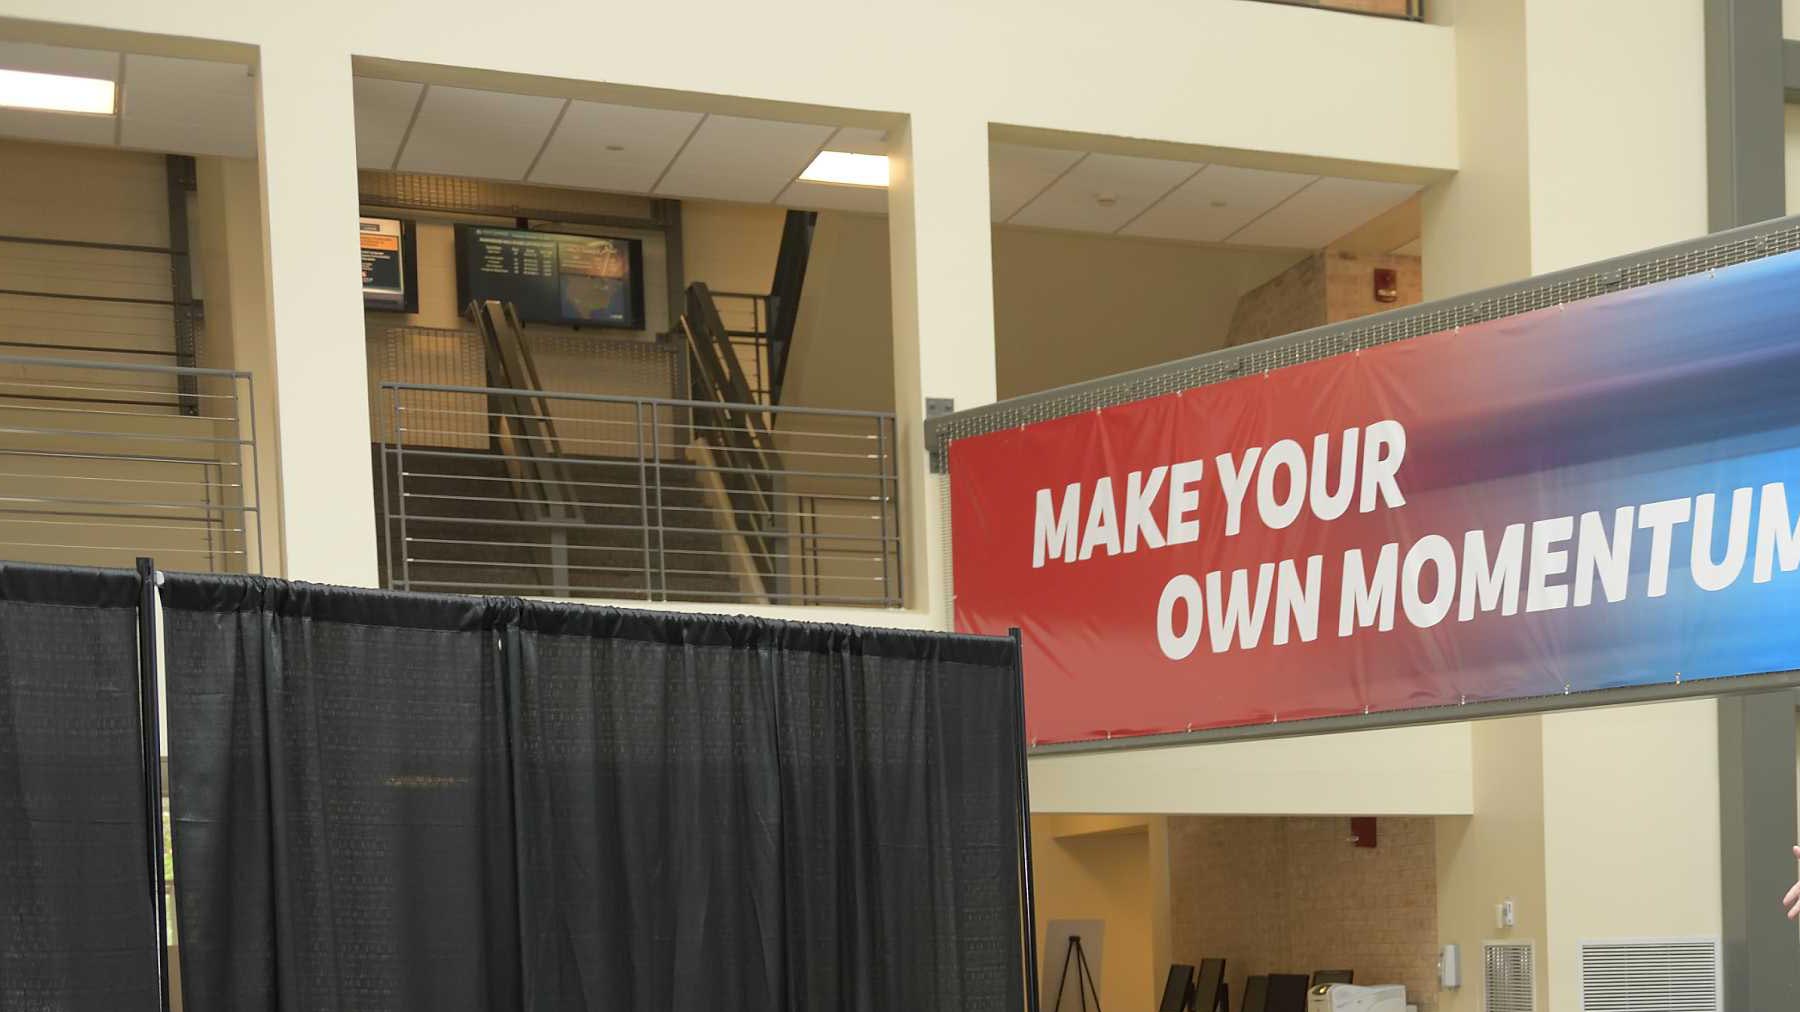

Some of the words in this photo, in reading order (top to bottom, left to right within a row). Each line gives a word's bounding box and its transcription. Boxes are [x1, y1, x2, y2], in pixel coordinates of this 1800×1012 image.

[1033, 459, 1203, 568] MAKE
[1214, 420, 1407, 536] YOUR
[1157, 554, 1323, 660] OWN
